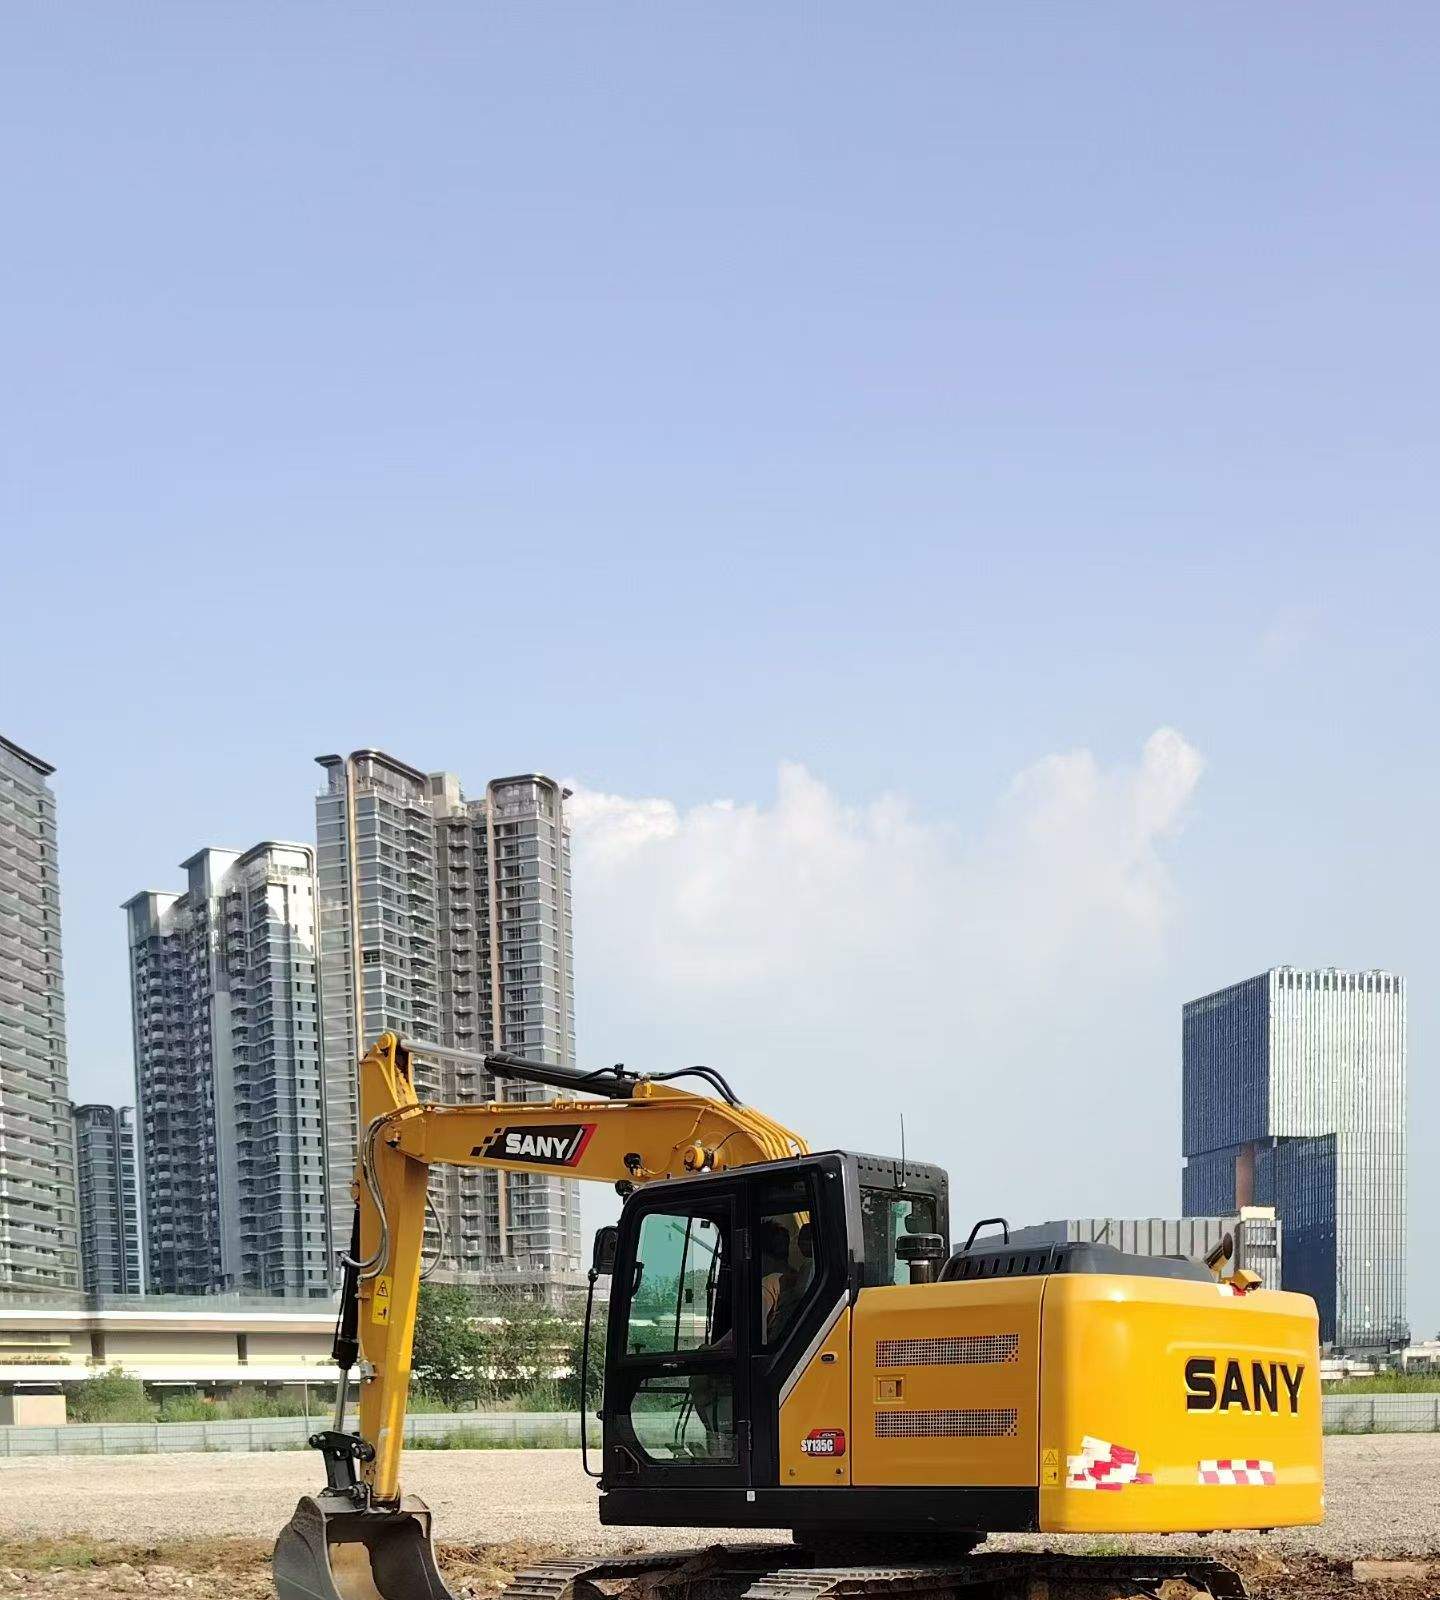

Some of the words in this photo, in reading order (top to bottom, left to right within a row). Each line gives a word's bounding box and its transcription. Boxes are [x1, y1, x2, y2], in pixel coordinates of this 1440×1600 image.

[505, 1133, 570, 1159] SANY
[1184, 1356, 1305, 1416] SANY
[800, 1439, 834, 1452] SY135C
